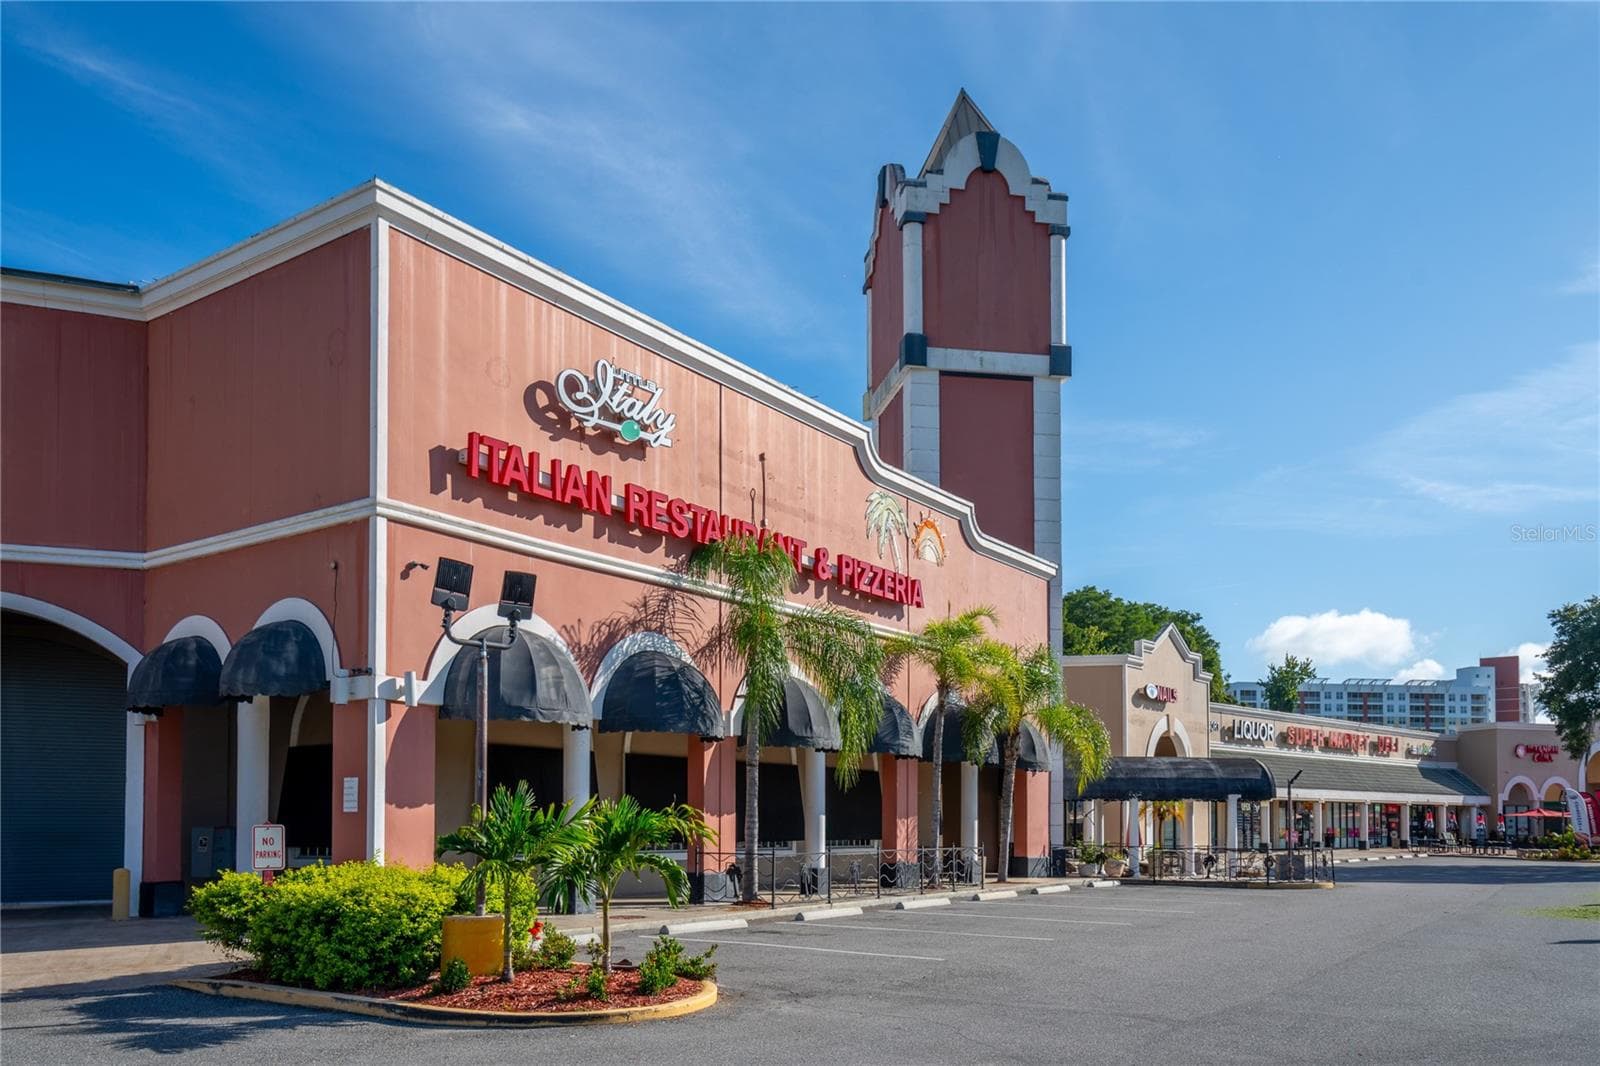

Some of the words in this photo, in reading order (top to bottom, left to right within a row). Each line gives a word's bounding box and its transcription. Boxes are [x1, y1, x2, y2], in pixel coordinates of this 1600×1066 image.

[555, 359, 676, 447] Italy
[467, 431, 612, 516] ITALIAN
[813, 547, 832, 581] &
[837, 553, 925, 608] PIZZERIA
[1156, 685, 1177, 703] NAILS
[1232, 720, 1275, 741] LIQUOR
[1287, 726, 1324, 748] SUPER
[1329, 731, 1371, 754] MARKET
[262, 837, 275, 846] NO
[255, 849, 282, 858] PARKING
